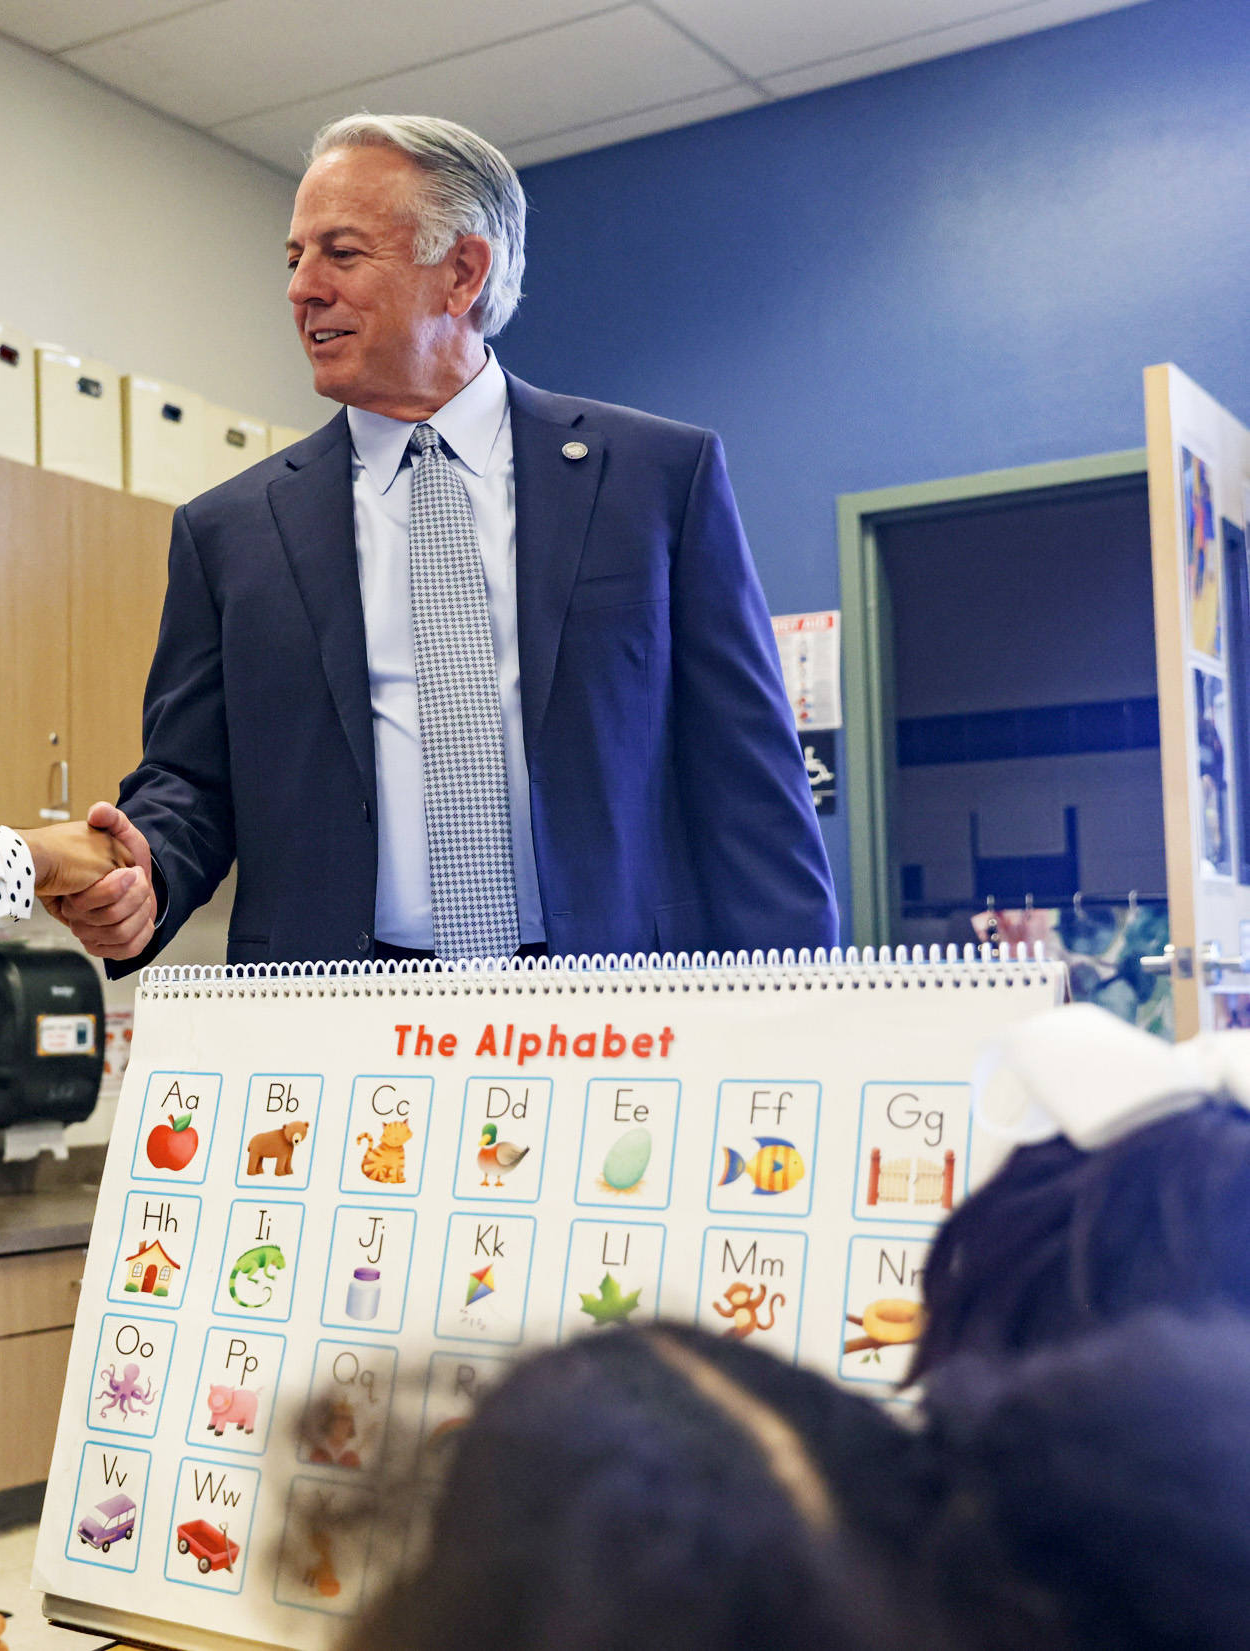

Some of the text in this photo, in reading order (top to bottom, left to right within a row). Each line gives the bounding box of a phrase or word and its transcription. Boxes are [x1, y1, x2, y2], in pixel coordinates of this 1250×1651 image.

[395, 1024, 675, 1066] The Alphabet
[161, 1081, 200, 1111] Aa
[266, 1083, 300, 1114] Bb
[371, 1085, 410, 1116] Cc
[486, 1087, 528, 1119] Dd
[613, 1089, 650, 1123] Ee
[749, 1091, 794, 1125] Ff
[886, 1093, 945, 1147] Gg
[142, 1201, 178, 1234] Hh
[254, 1210, 272, 1241] Ii
[358, 1217, 386, 1264] Jj
[474, 1224, 506, 1258] Kk
[602, 1231, 631, 1267] Ll
[721, 1239, 784, 1279] Mm
[115, 1325, 154, 1359] Oo
[225, 1339, 259, 1385] Pp
[333, 1351, 379, 1404] Qq
[102, 1453, 128, 1488] Vv
[193, 1469, 242, 1508] Ww
